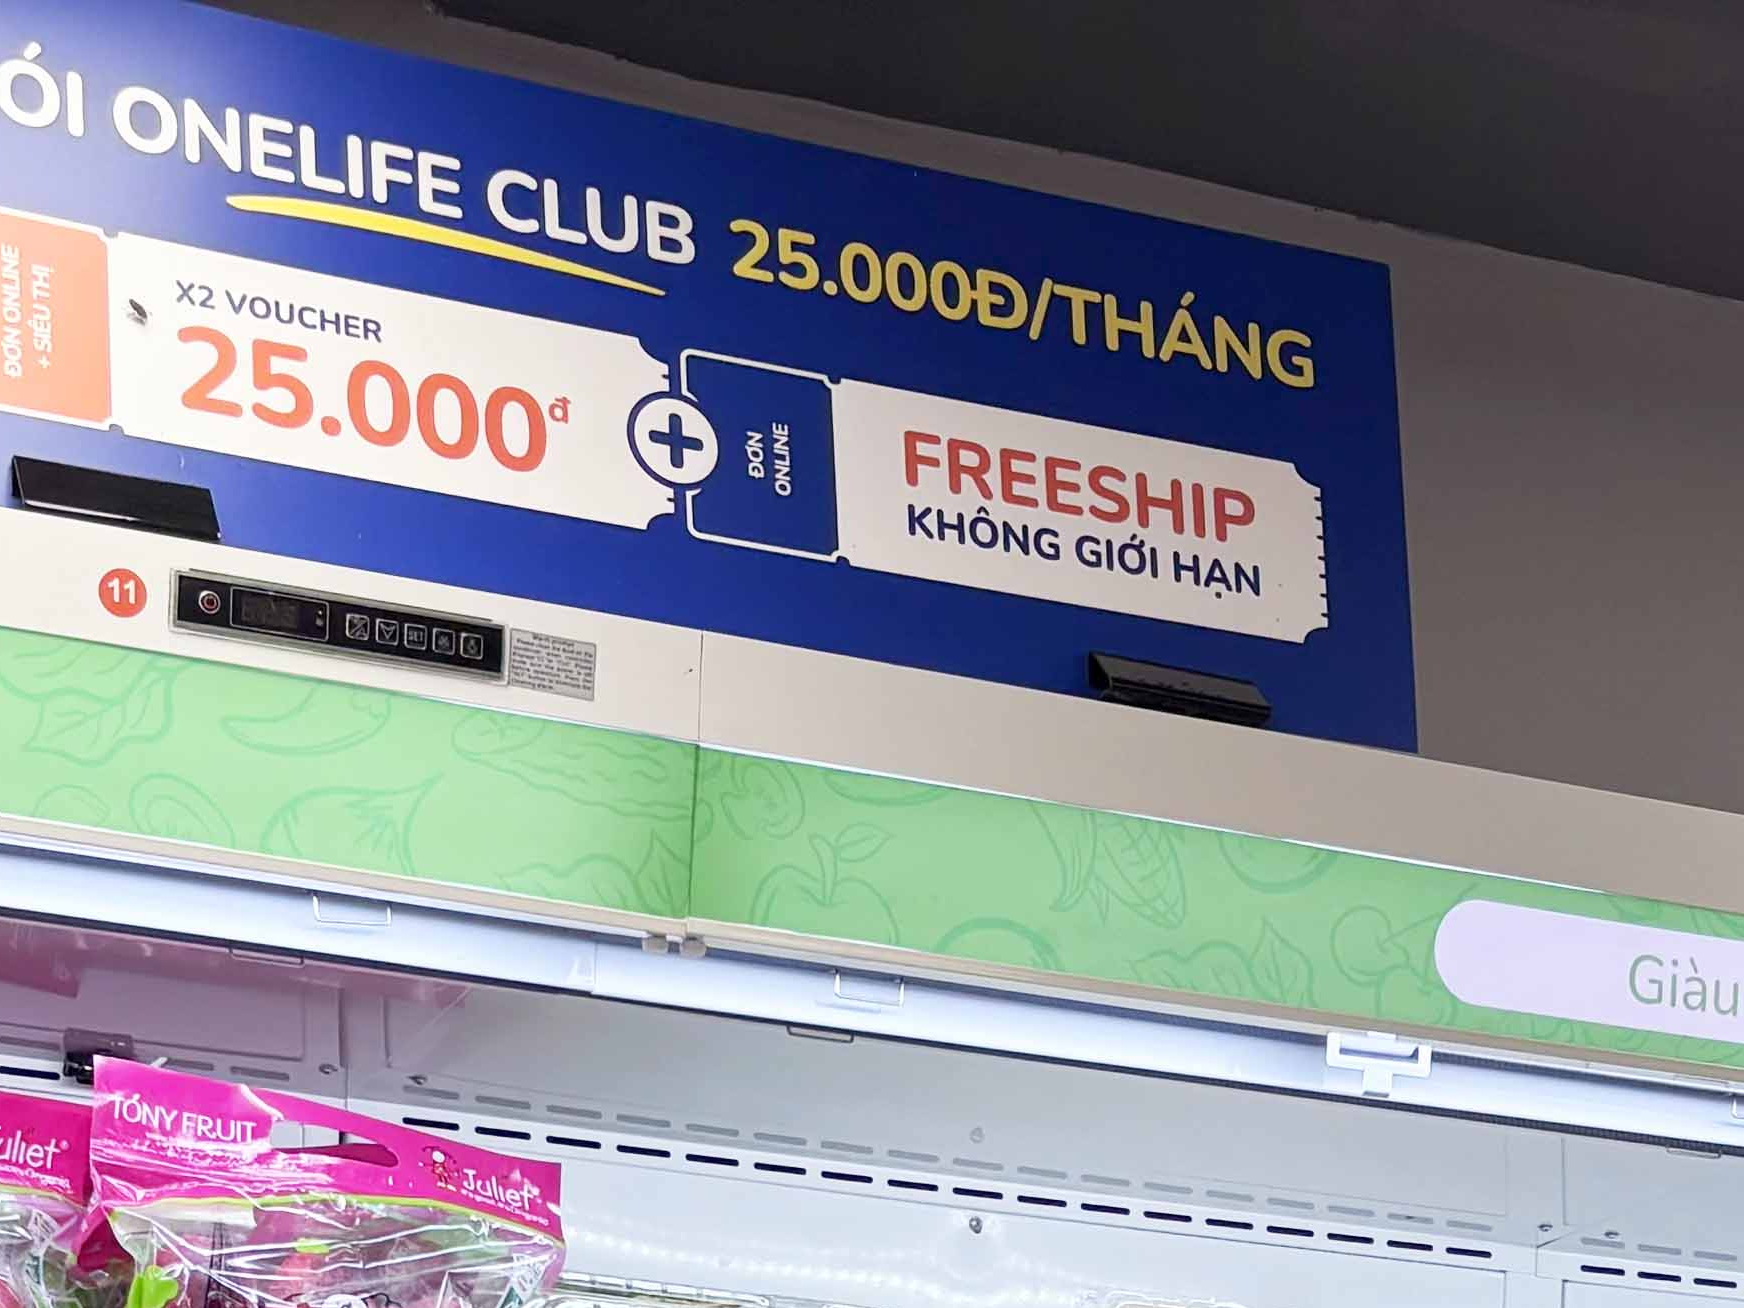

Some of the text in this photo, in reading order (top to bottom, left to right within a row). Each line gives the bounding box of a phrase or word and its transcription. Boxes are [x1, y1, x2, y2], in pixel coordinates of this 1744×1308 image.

[112, 87, 462, 220] ONELIFE
[488, 170, 695, 264] CLUB
[729, 218, 1315, 388] 25.000Đ/THÁNG
[1, 244, 20, 320] ONLINE
[175, 280, 382, 343] X2 VOUCHER
[774, 422, 790, 496] ONLINE
[904, 430, 1256, 543] FREESHIP
[907, 505, 1261, 599] KHÔNG GIỚI HẠN
[107, 577, 138, 605] 11
[1627, 953, 1739, 1018] Giàu
[182, 1112, 257, 1143] FRUIT
